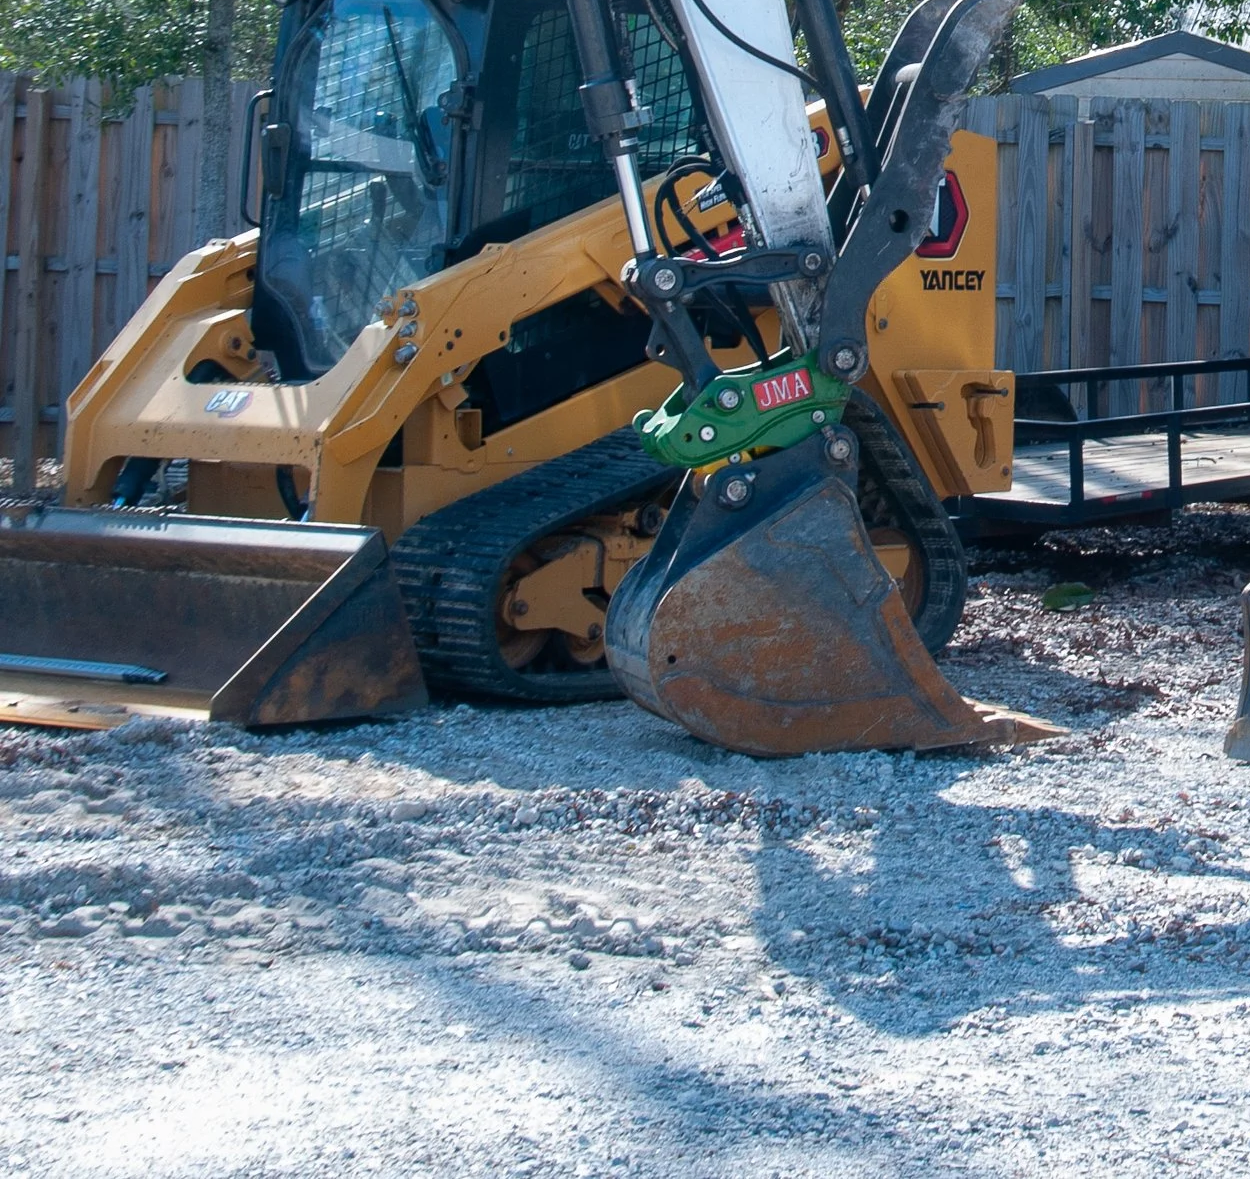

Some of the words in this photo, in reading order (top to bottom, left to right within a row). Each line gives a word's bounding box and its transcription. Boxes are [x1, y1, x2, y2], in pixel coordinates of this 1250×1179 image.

[568, 133, 590, 150] CAT
[919, 269, 986, 291] YANCEY
[205, 389, 250, 412] CAT
[761, 372, 809, 407] JMA
